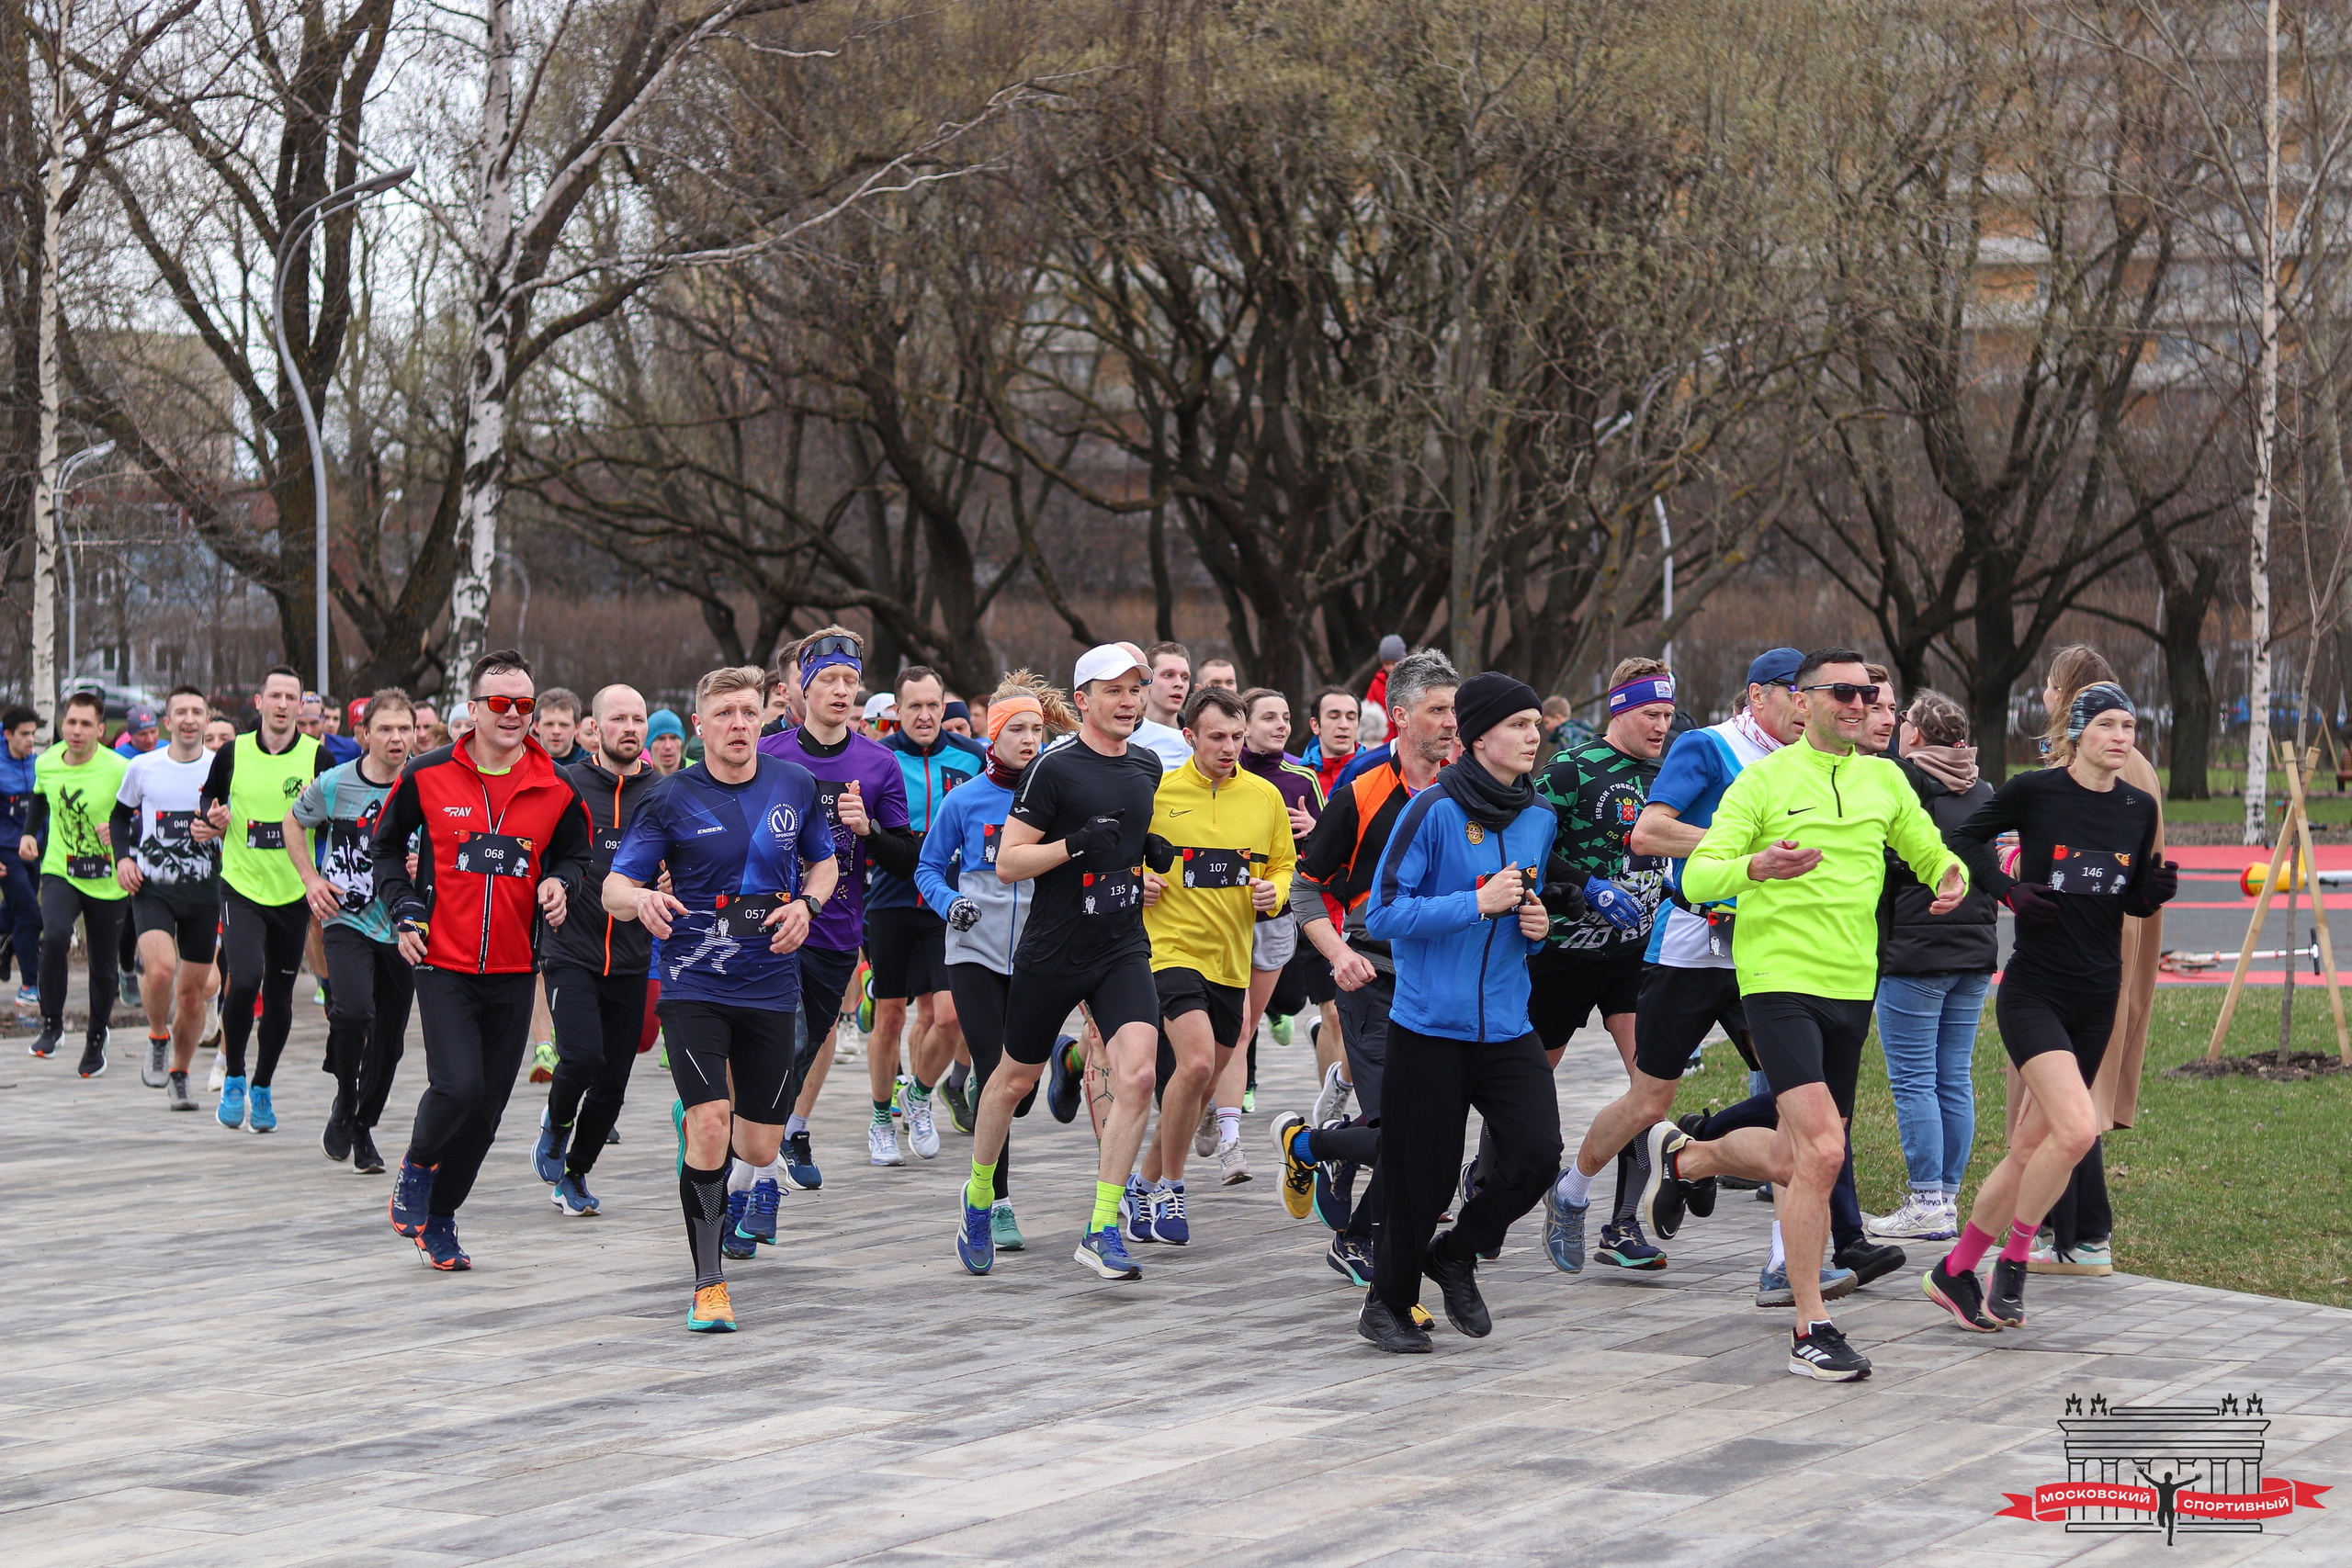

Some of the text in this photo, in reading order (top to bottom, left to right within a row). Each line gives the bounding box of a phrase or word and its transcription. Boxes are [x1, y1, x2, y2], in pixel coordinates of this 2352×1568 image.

[266, 829, 280, 840] 121
[696, 825, 723, 835] ENSEN
[484, 848, 504, 860] 068
[1209, 863, 1227, 873] 107
[2082, 866, 2104, 878] 146
[1110, 884, 1126, 897] 135
[745, 908, 766, 919] 057
